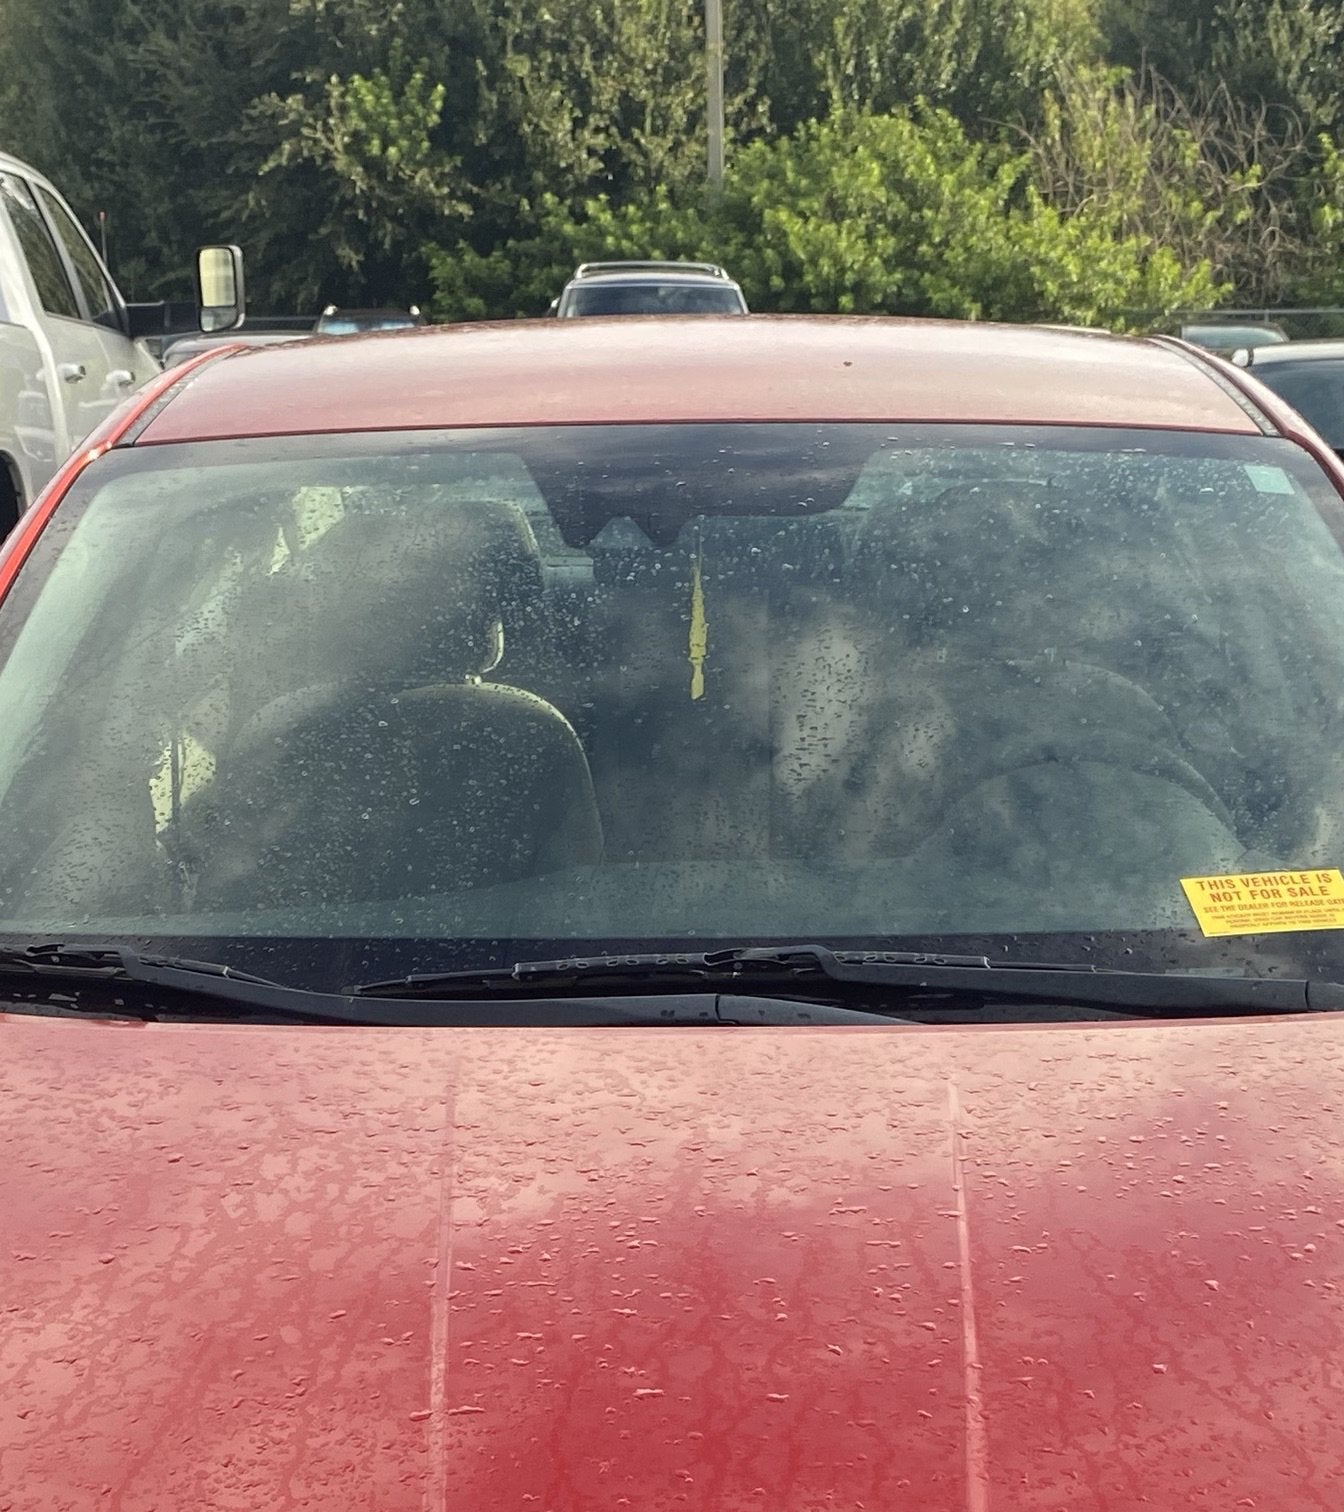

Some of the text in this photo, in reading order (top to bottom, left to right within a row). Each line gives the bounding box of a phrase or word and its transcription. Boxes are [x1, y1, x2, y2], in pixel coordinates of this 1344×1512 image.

[1196, 872, 1333, 891] THIS VEHICLE IS
[1210, 885, 1331, 903] NOT FOR SALE
[1238, 903, 1269, 911] DEALER
[1289, 899, 1325, 907] RELEASE
